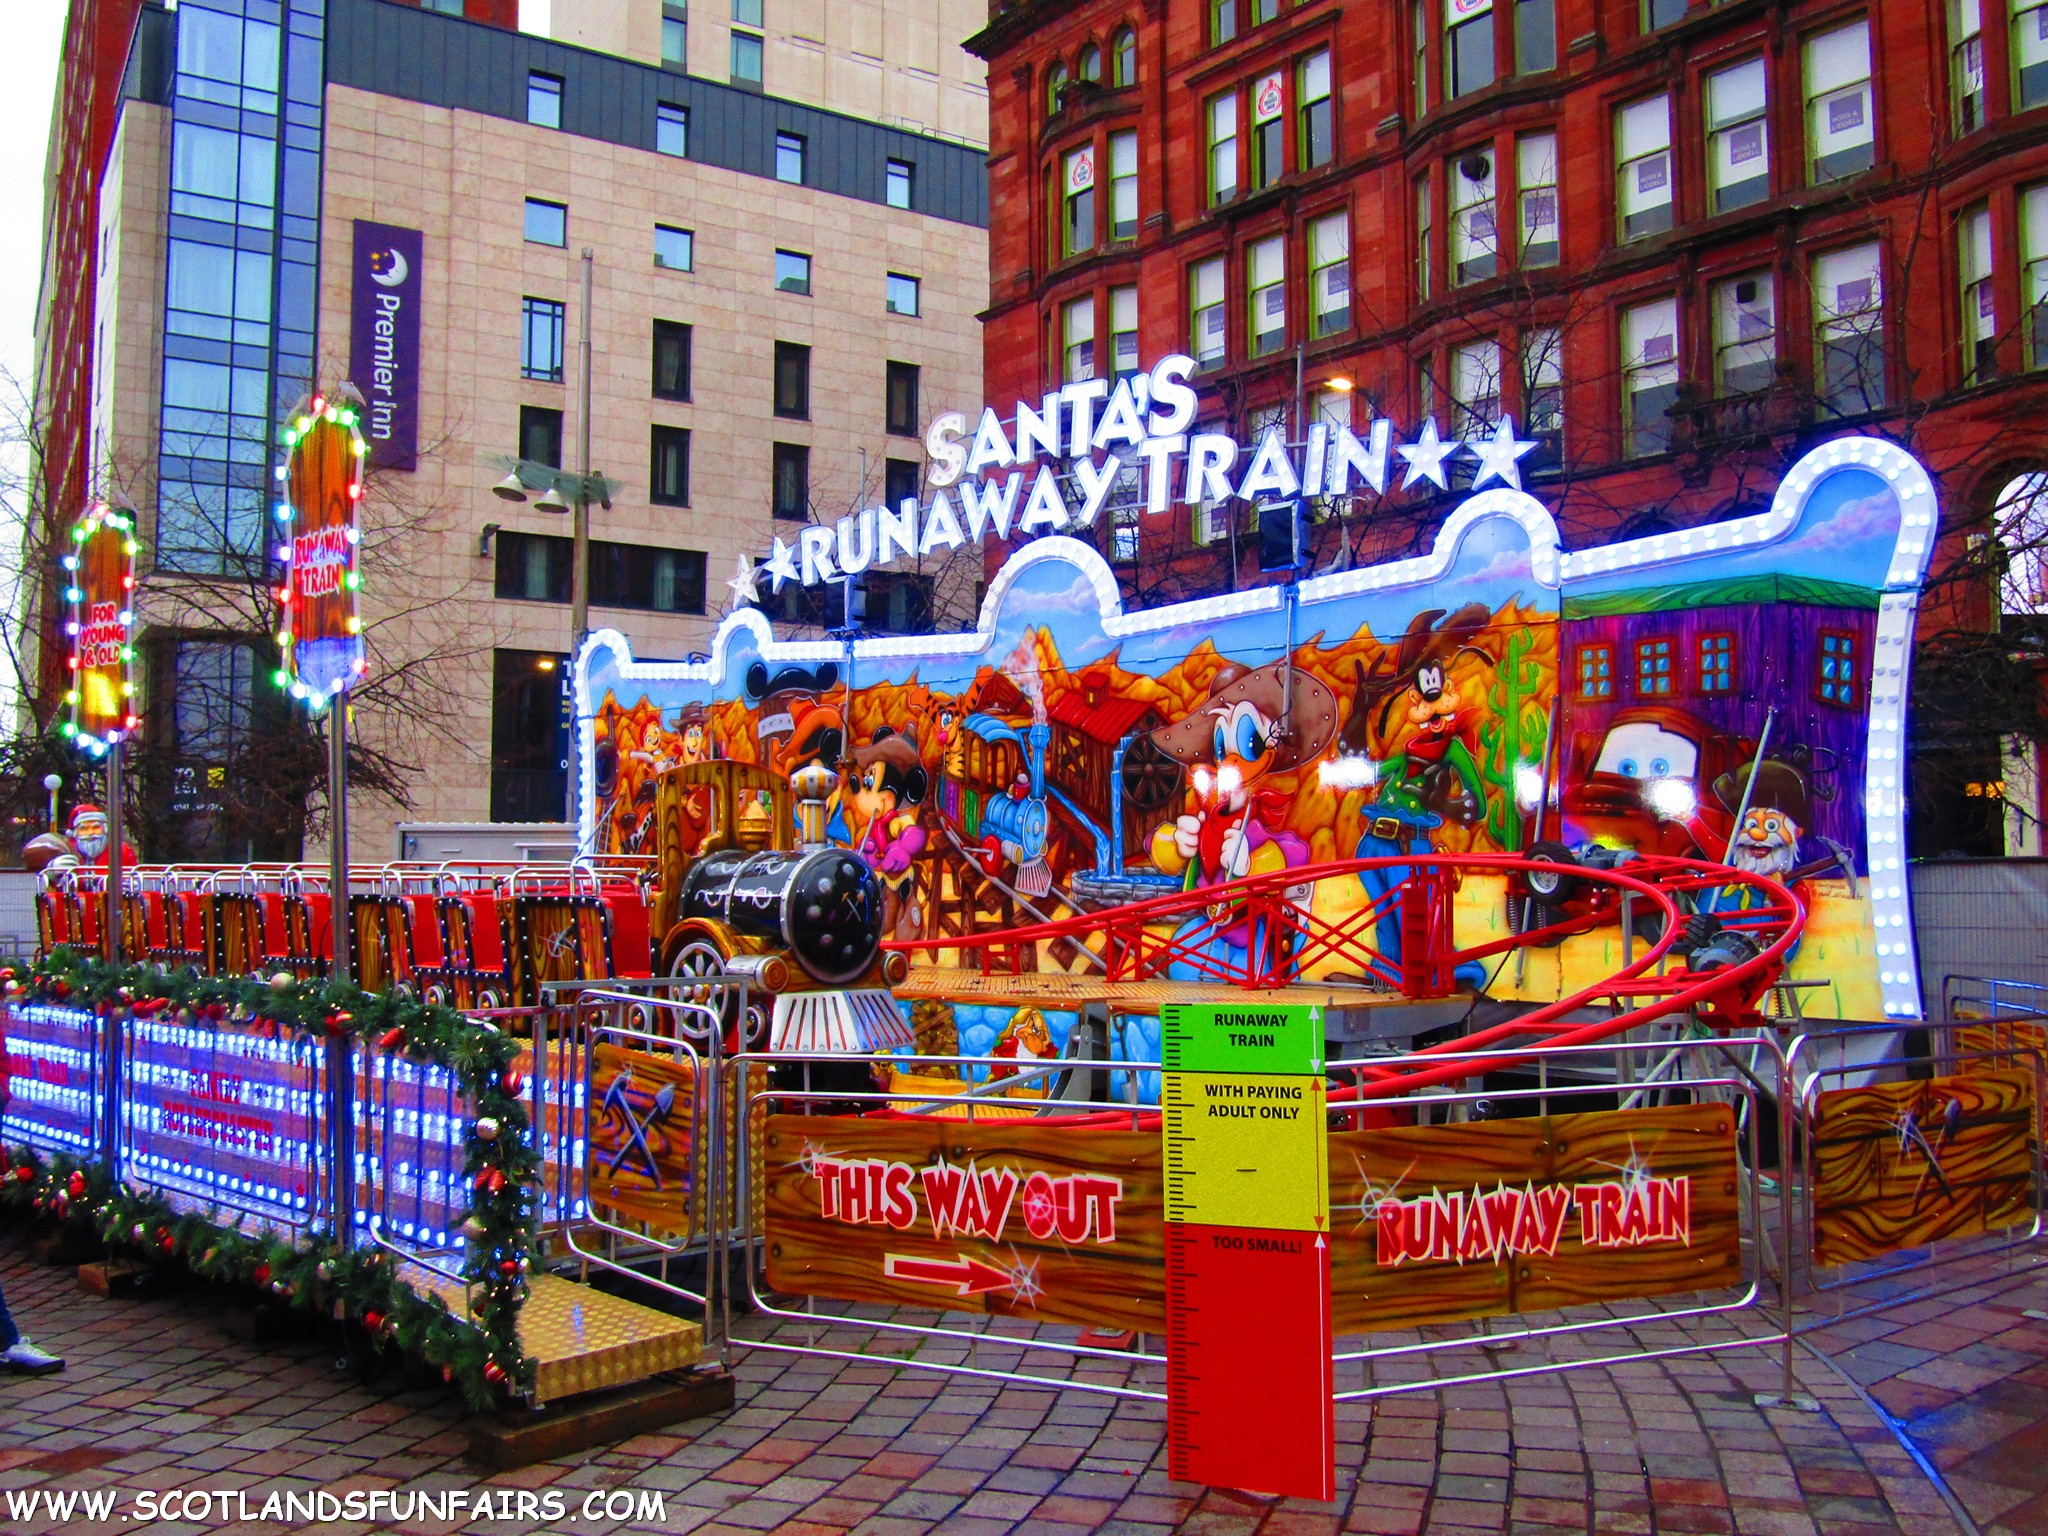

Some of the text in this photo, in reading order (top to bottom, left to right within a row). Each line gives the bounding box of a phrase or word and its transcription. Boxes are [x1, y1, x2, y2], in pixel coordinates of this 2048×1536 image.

[371, 293, 401, 440] Premier Inn
[926, 354, 1199, 486] SANTA'S
[800, 418, 1394, 587] RUNAWAY TRAIN
[293, 524, 351, 569] RUNAWAY
[303, 563, 341, 598] TRAIN
[92, 601, 117, 626] FOR
[80, 622, 126, 649] YOUNG
[84, 643, 121, 668] & OLD
[1214, 1013, 1288, 1027] RUNAWAY
[1228, 1034, 1275, 1047] TRAIN
[1205, 1084, 1302, 1099] WITH PAYING
[1208, 1104, 1299, 1119] ADULT ONLY
[812, 1153, 1123, 1244] THIS WAY OUT
[1376, 1175, 1690, 1268] RUNAWAY TRAIN
[1211, 1235, 1303, 1254] TOO SMALL!
